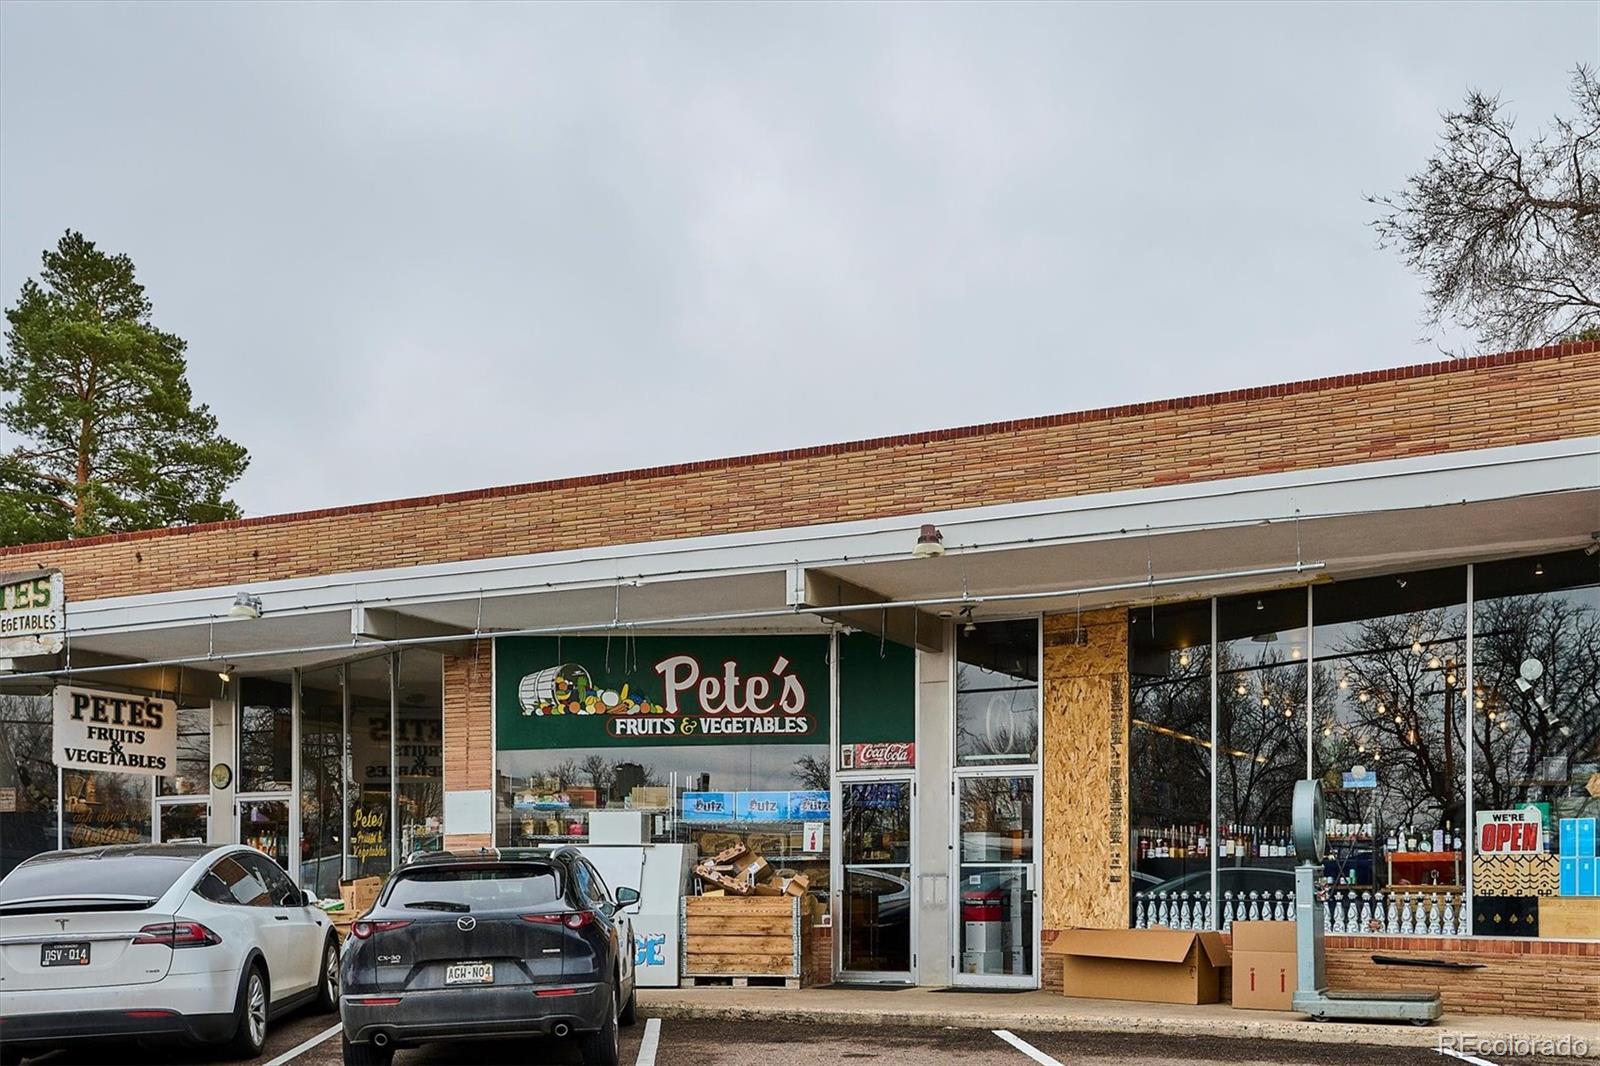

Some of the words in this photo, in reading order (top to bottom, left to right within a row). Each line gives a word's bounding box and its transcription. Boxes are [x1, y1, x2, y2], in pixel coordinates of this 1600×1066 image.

[0, 614, 57, 632] EGETABLES
[654, 655, 806, 715] Pete's
[70, 691, 163, 729] PETE'S
[87, 726, 145, 744] FRUITS
[615, 717, 676, 735] FRUITS
[679, 717, 697, 735] &
[699, 717, 808, 735] VEGETABLES
[109, 740, 123, 754] &
[64, 748, 167, 770] VEGETABLES
[1492, 813, 1525, 822] WE'RE
[1481, 822, 1538, 852] OPEN
